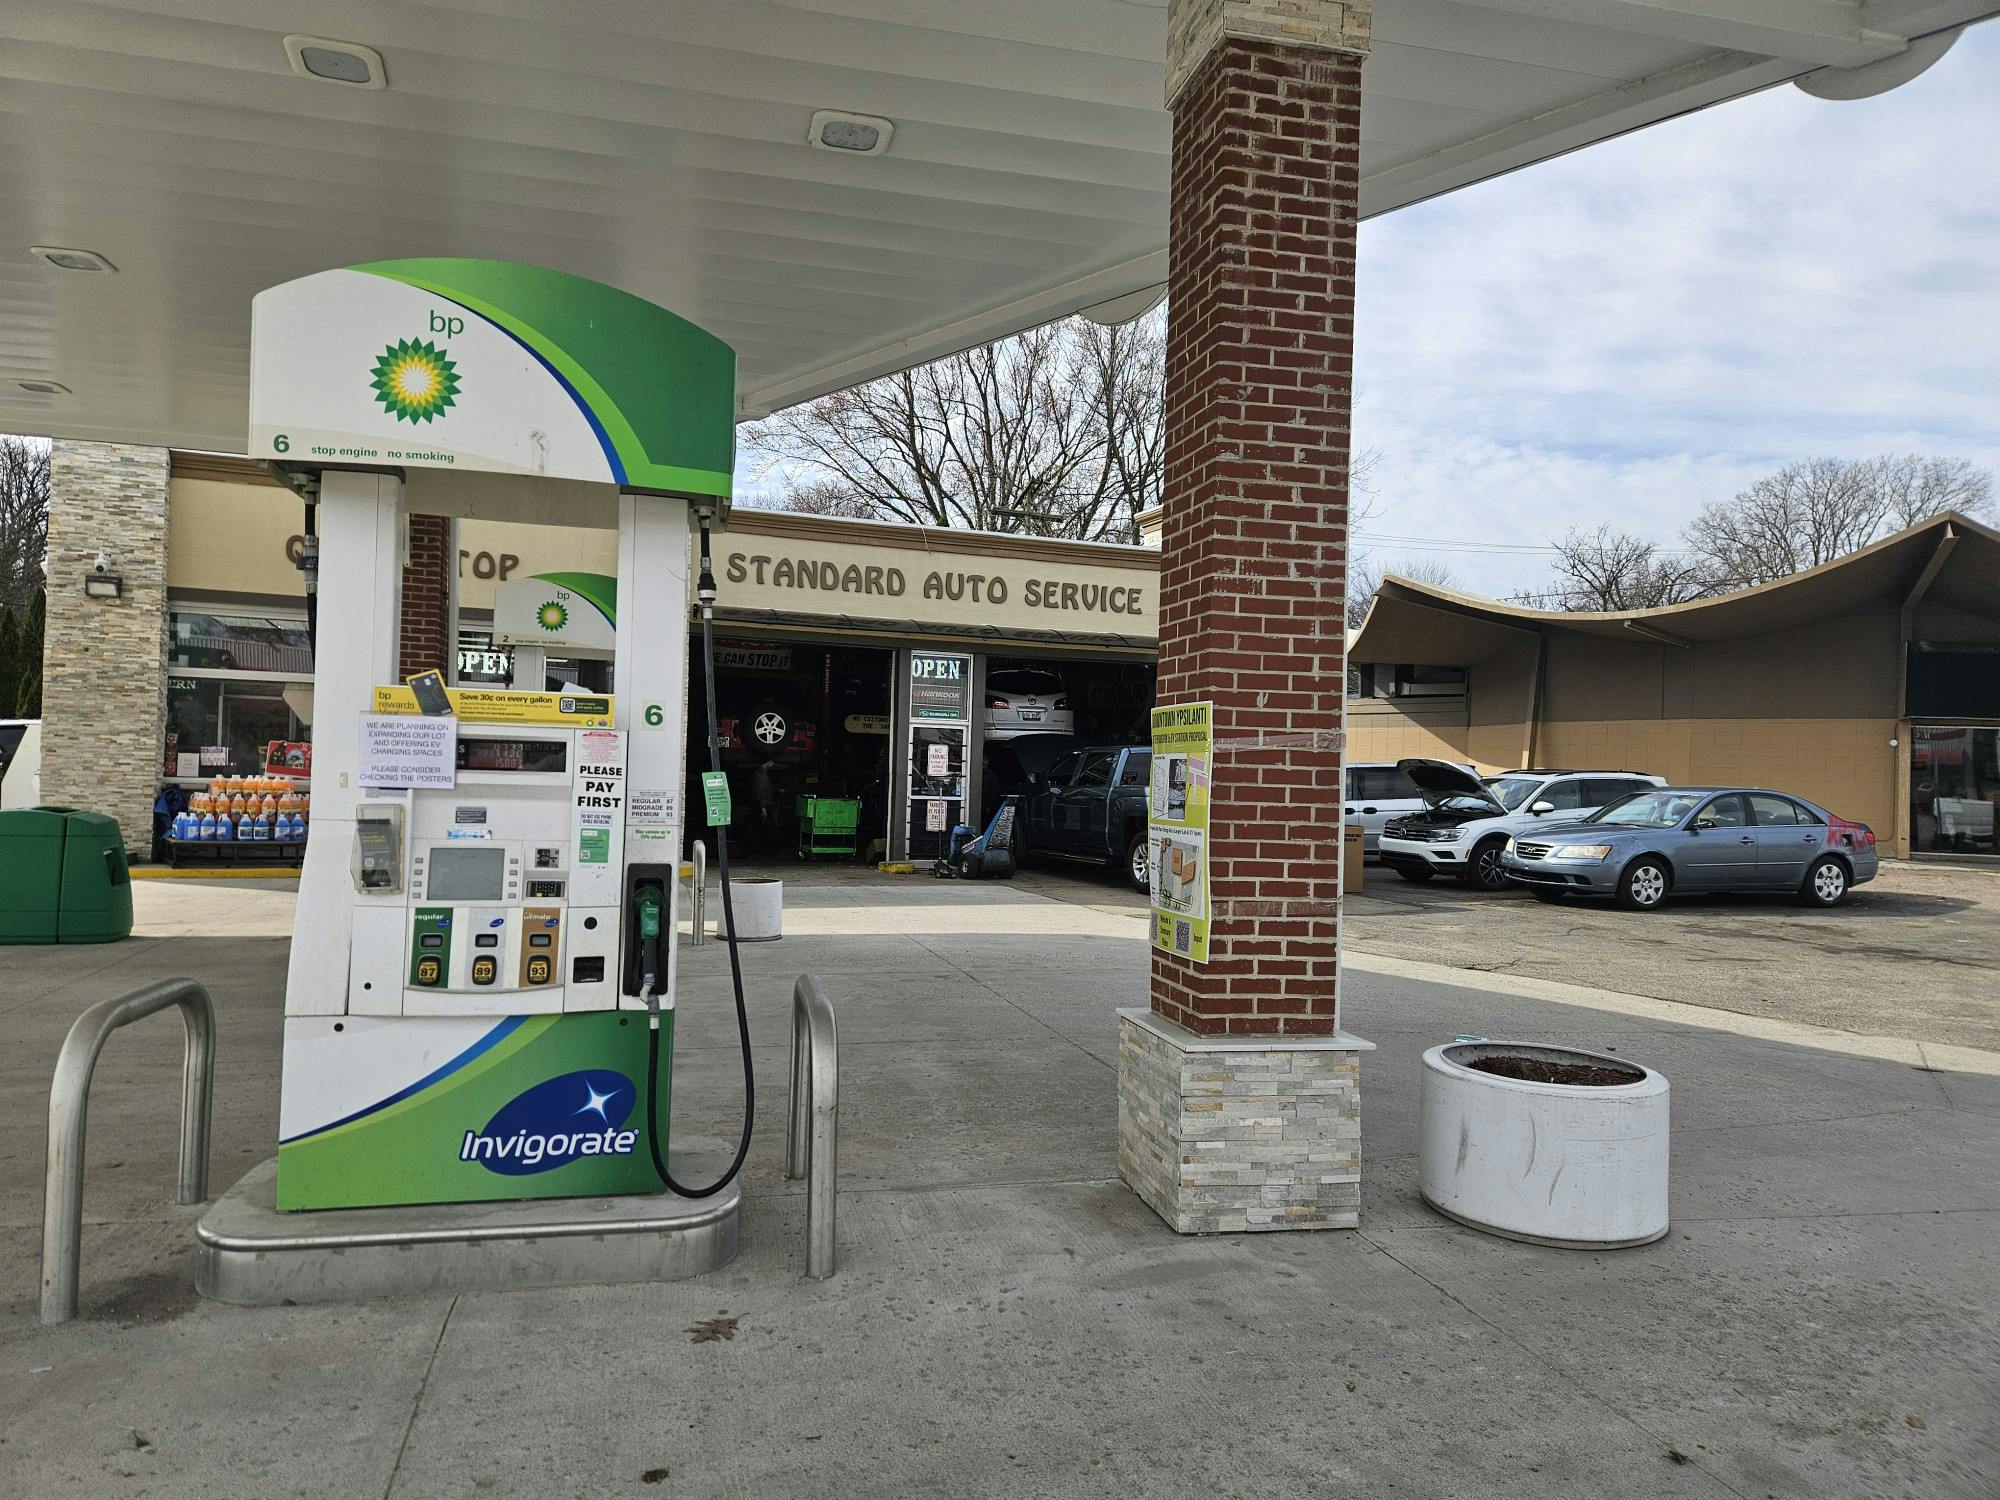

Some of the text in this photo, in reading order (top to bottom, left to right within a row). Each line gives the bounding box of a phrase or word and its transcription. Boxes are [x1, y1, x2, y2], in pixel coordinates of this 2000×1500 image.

[429, 310, 465, 339] bp
[273, 434, 290, 453] 6
[311, 446, 378, 458] stop engine
[387, 450, 455, 463] no smoking
[726, 552, 1143, 615] STANDARD AUTO SERVICE
[557, 591, 570, 602] bp
[503, 635, 509, 643] 2
[723, 652, 745, 665] CAN
[747, 653, 777, 668] STOP
[778, 656, 790, 667] IT
[911, 658, 961, 679] OPEN
[378, 691, 391, 700] bp
[459, 693, 479, 701] Save
[529, 696, 552, 704] gallon
[378, 700, 415, 709] rewards
[644, 704, 663, 726] 6
[1176, 707, 1207, 726] YPSILANTI
[396, 723, 436, 731] PLANNING
[412, 749, 443, 757] SPACES
[400, 766, 441, 774] CONSIDER
[580, 765, 623, 776] PLEASE
[416, 775, 452, 783] POSTERS
[585, 781, 615, 793] PAY
[577, 796, 622, 808] FIRST
[414, 913, 444, 921] regular
[420, 968, 435, 977] 87
[475, 967, 491, 976] 89
[531, 967, 546, 976] 93
